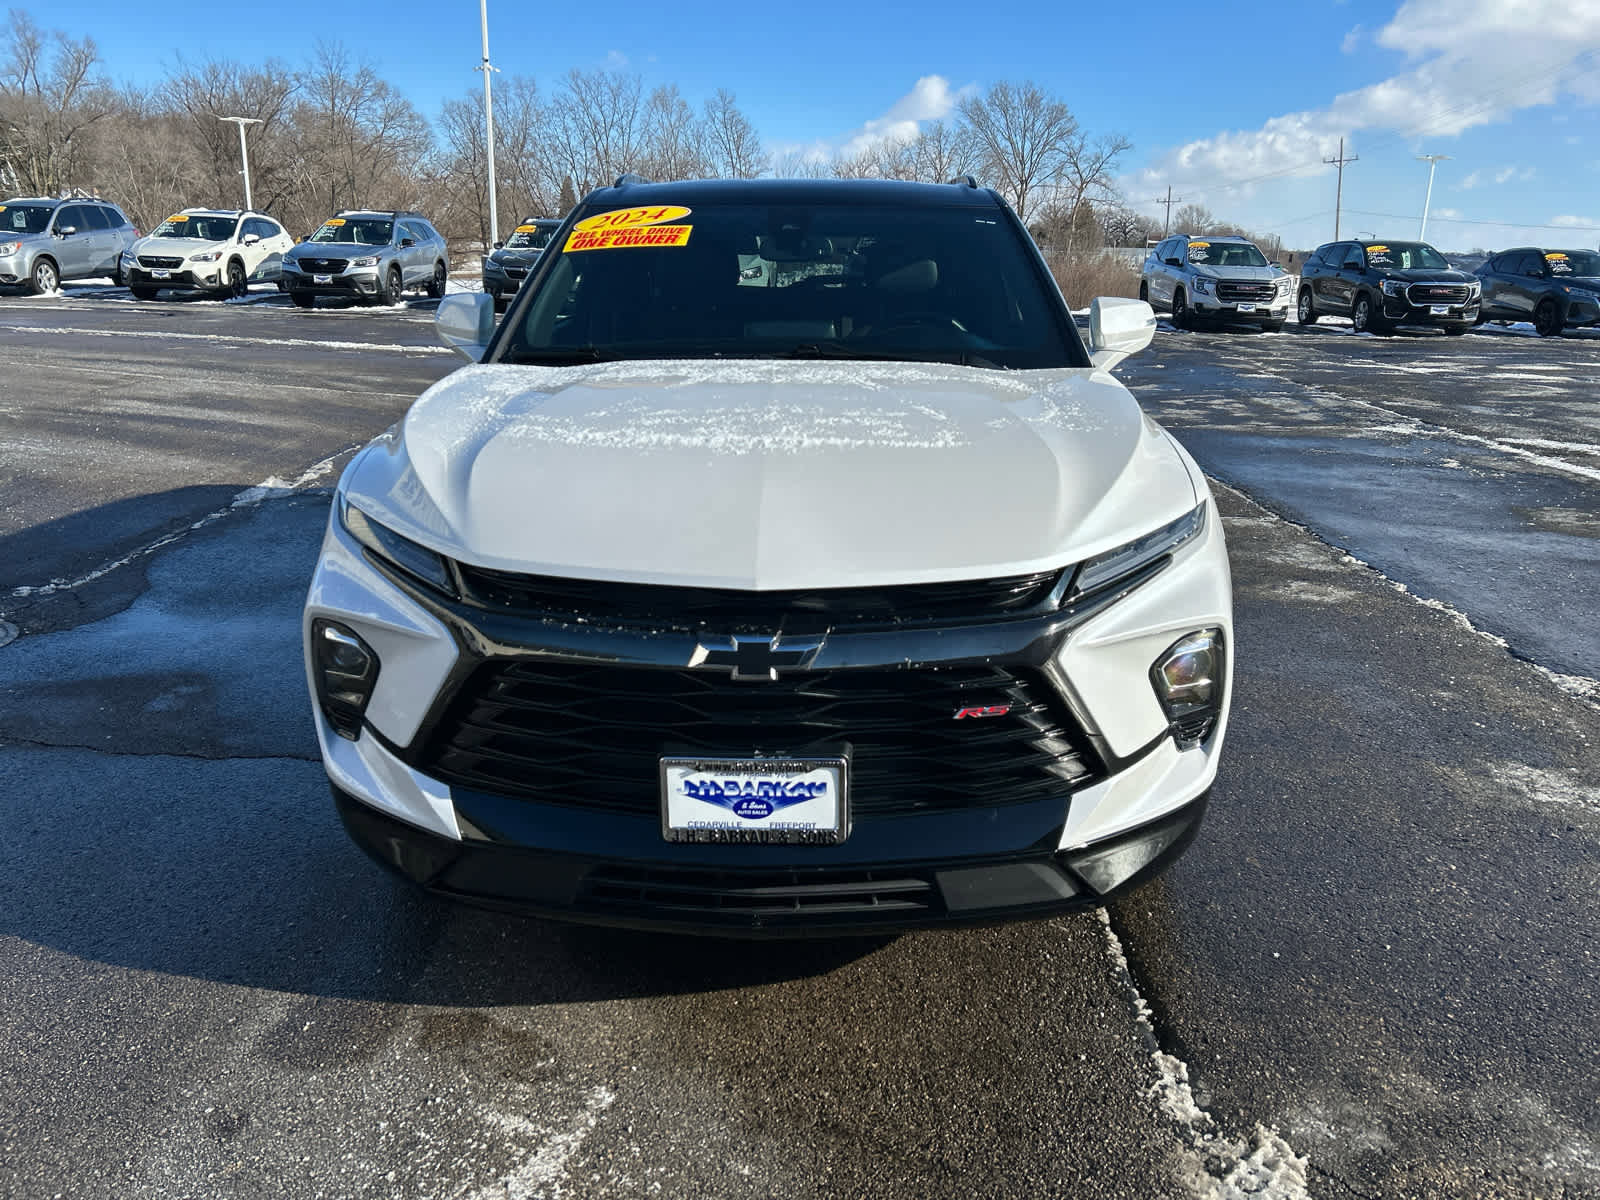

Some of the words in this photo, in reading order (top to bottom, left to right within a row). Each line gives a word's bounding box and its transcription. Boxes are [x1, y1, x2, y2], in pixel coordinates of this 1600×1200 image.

[590, 208, 669, 230] 2024
[573, 231, 599, 240] ALL
[600, 228, 643, 238] WHEEL
[646, 227, 689, 235] DRIVE
[571, 237, 611, 250] ONE
[612, 234, 680, 247] OWNER
[952, 705, 1009, 719] RS
[724, 781, 828, 798] BARKAU
[687, 820, 743, 829] CEDARVILLE
[769, 821, 817, 830] FREEPORT
